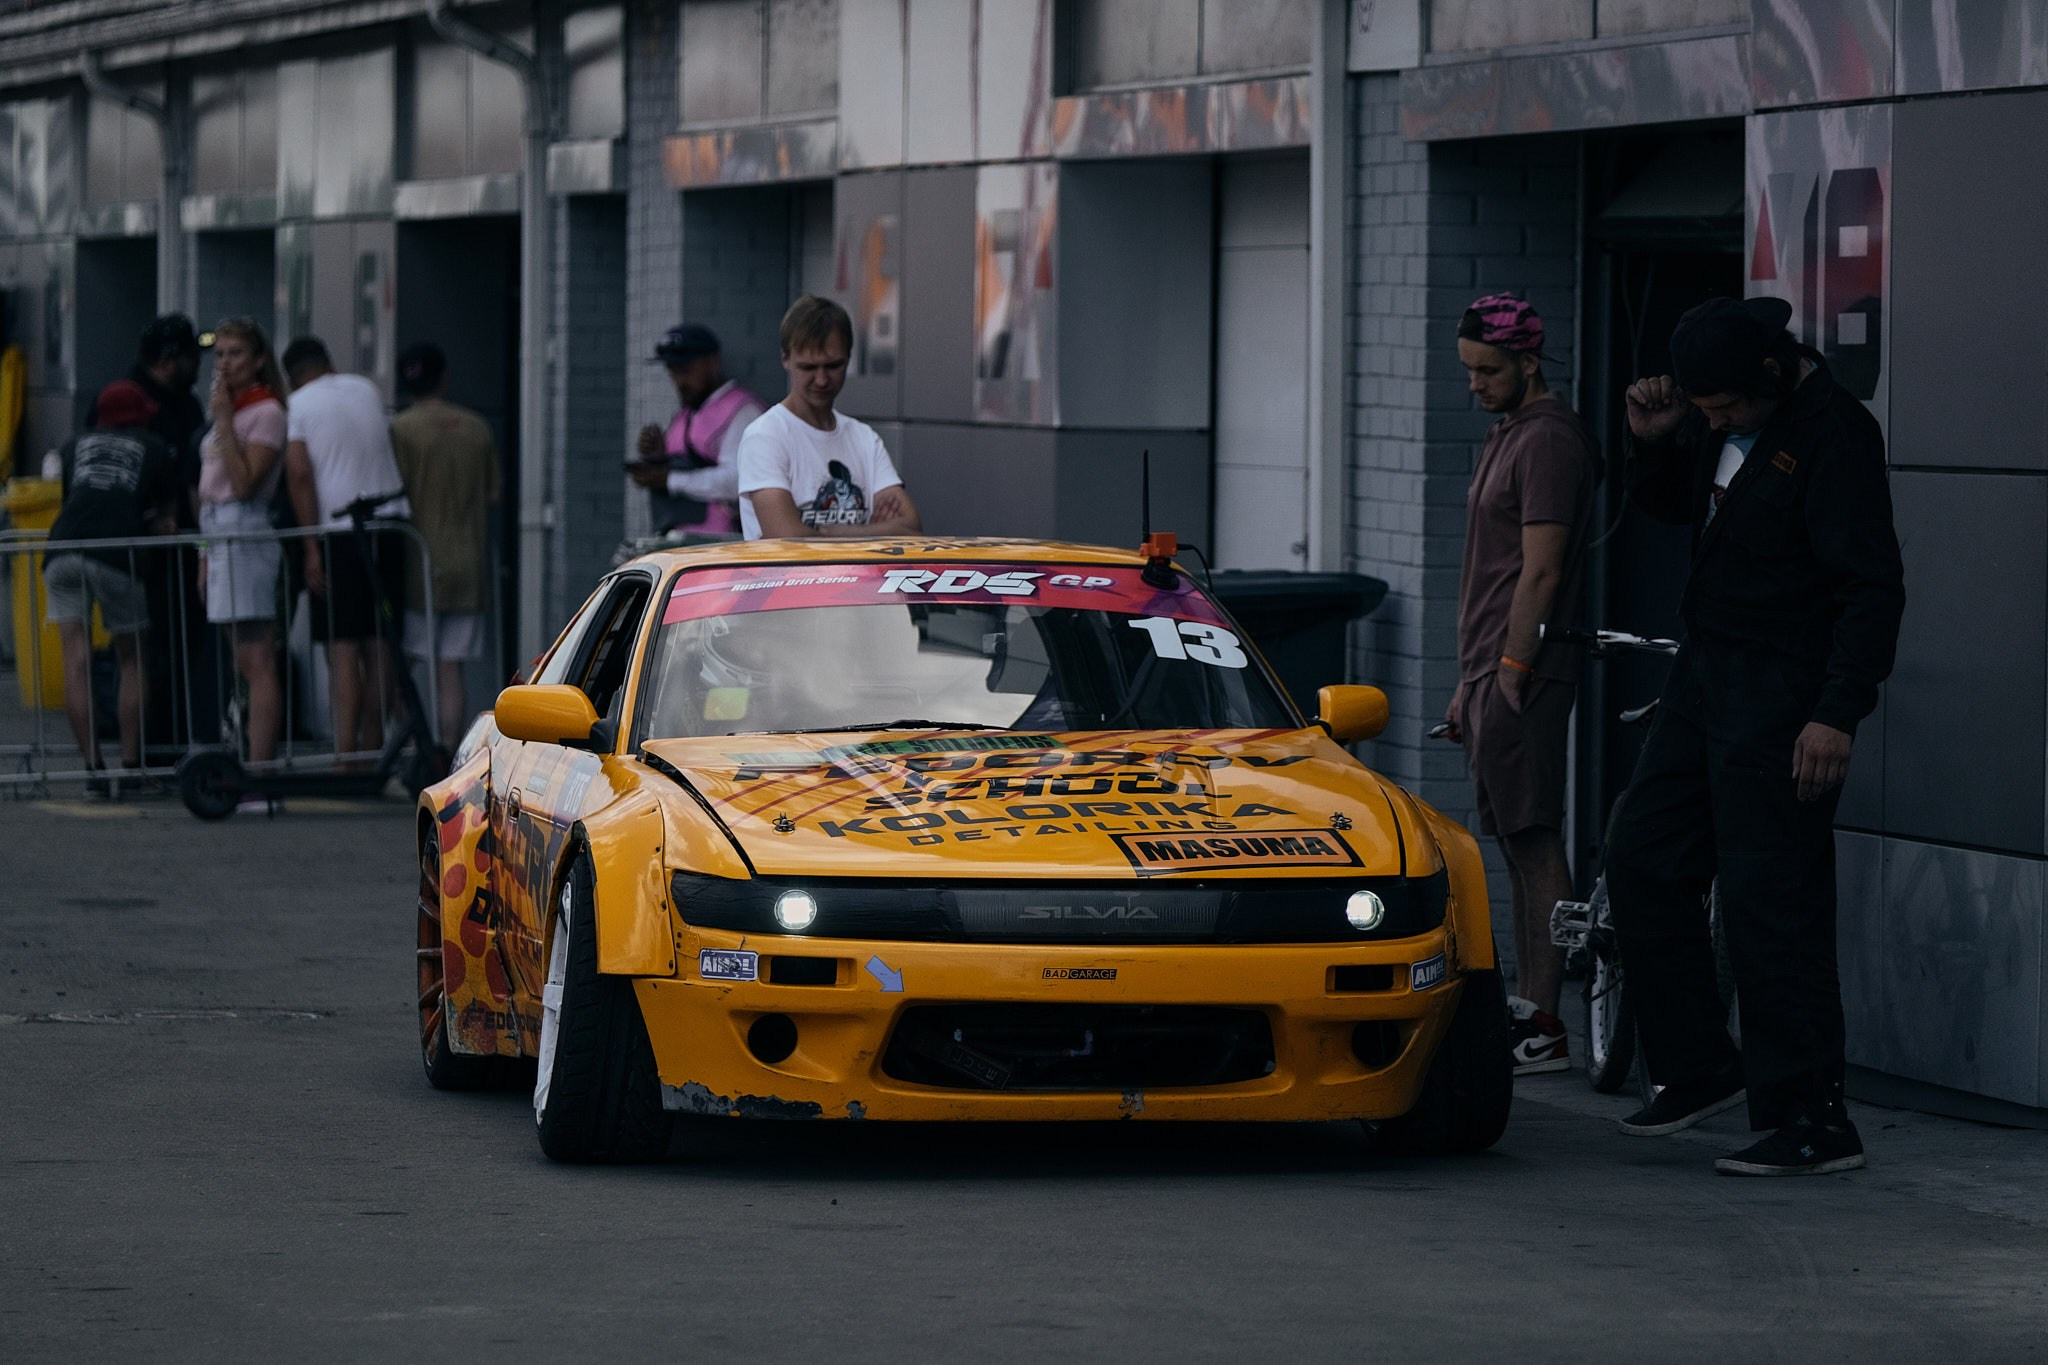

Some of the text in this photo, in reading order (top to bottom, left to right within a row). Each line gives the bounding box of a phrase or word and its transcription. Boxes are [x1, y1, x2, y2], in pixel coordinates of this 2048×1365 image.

[730, 569, 1113, 596] Russian Drift Series RDS GP
[1128, 616, 1249, 669] 13
[818, 801, 1297, 838] KOLORIKA
[907, 819, 1238, 846] DETAILING
[1136, 836, 1340, 862] MASUMA
[1018, 905, 1160, 919] SILVIA
